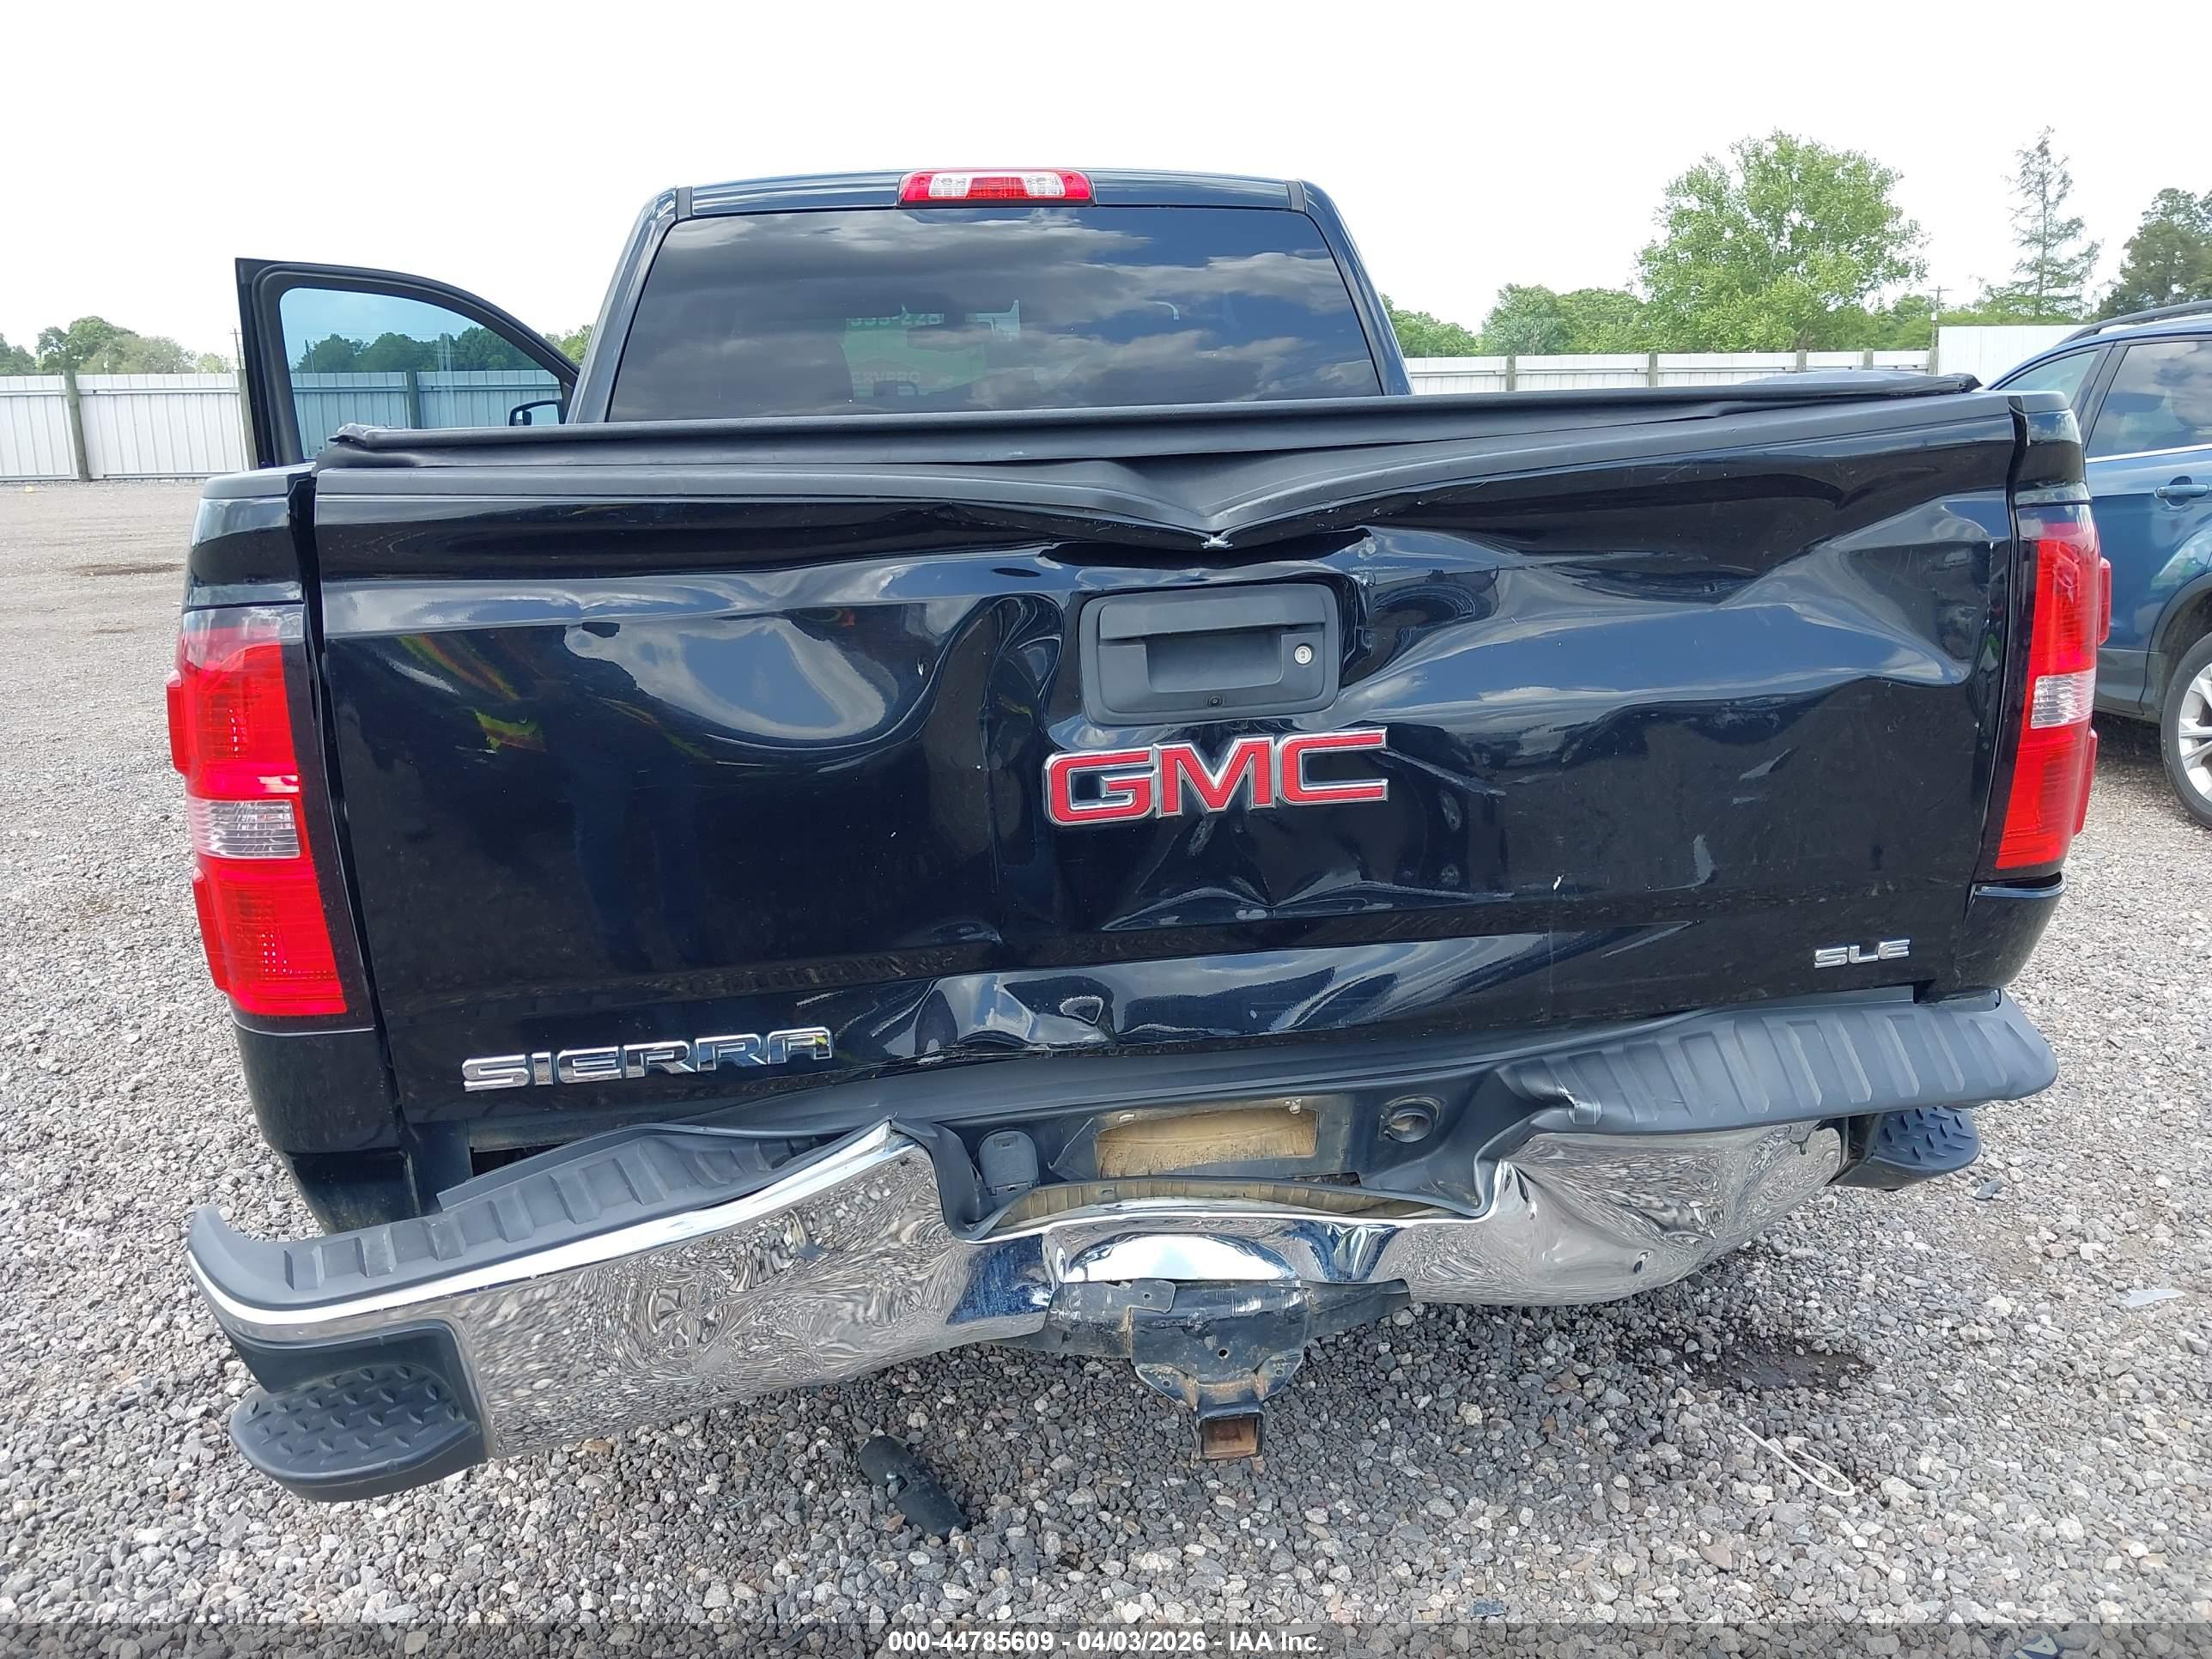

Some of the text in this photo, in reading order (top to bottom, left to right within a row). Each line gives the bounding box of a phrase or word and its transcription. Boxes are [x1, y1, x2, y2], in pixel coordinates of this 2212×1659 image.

[851, 370, 921, 385] ERVPRO
[1043, 726, 1389, 827] GMC
[1814, 938, 1911, 969] SLE
[461, 1025, 834, 1092] SIERRA
